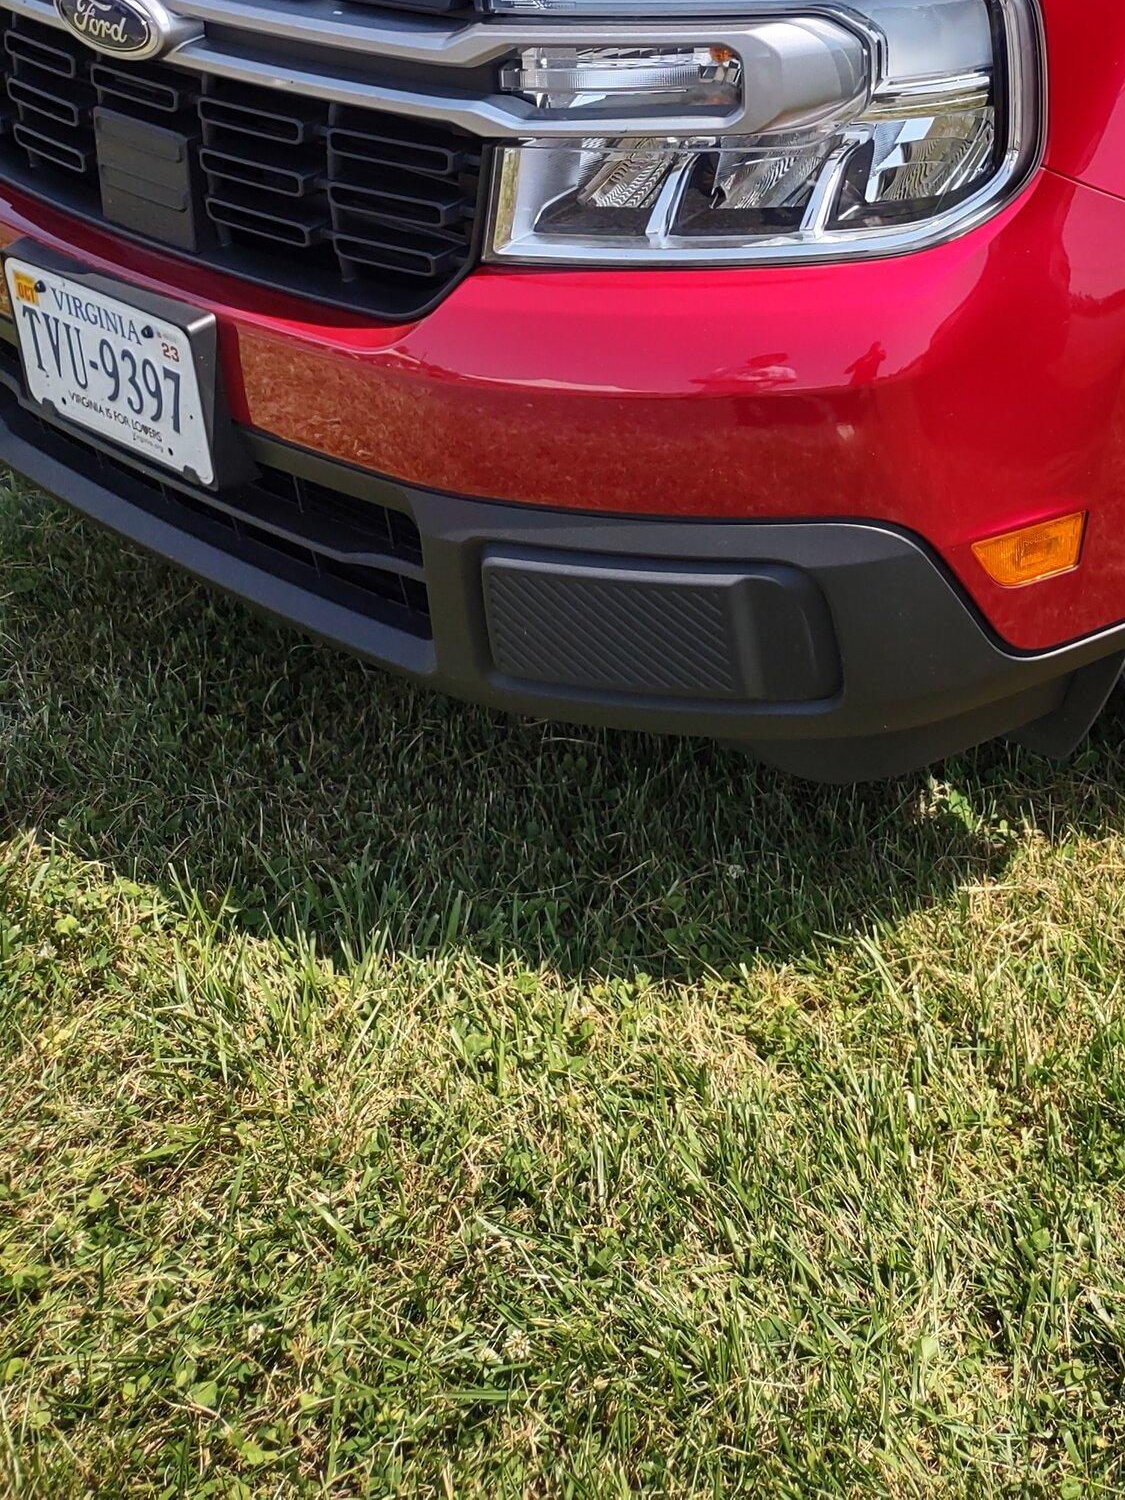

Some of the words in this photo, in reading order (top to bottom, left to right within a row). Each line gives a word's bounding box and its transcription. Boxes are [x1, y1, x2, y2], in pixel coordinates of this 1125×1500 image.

[17, 281, 36, 302] OCT
[50, 287, 143, 346] VIRGINIA
[22, 305, 181, 435] TVU-9397
[161, 342, 180, 363] 23
[68, 389, 104, 415] VIRGINIA
[113, 411, 131, 428] FOR
